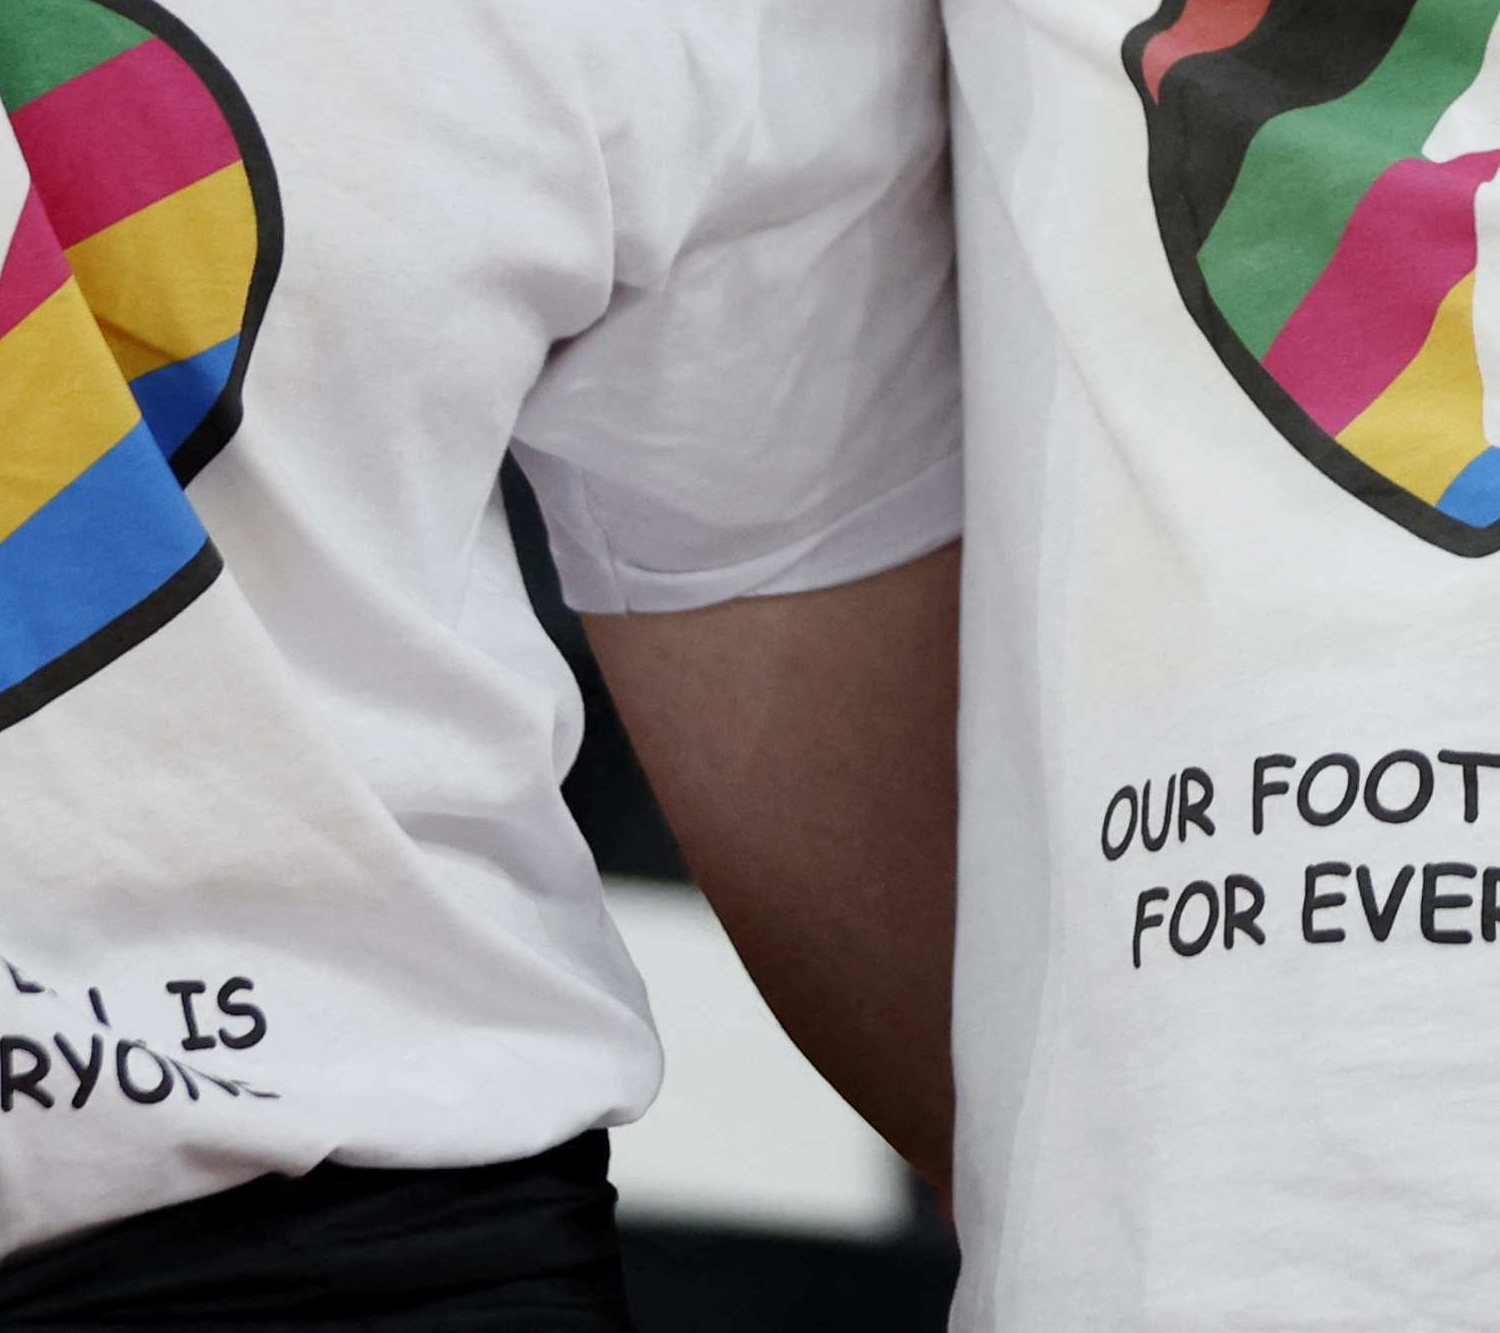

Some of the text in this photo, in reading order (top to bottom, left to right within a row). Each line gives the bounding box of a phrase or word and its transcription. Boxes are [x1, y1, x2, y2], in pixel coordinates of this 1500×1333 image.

[1100, 766, 1216, 862] OUR
[1131, 873, 1267, 969] FOR
[165, 975, 268, 1052] IS
